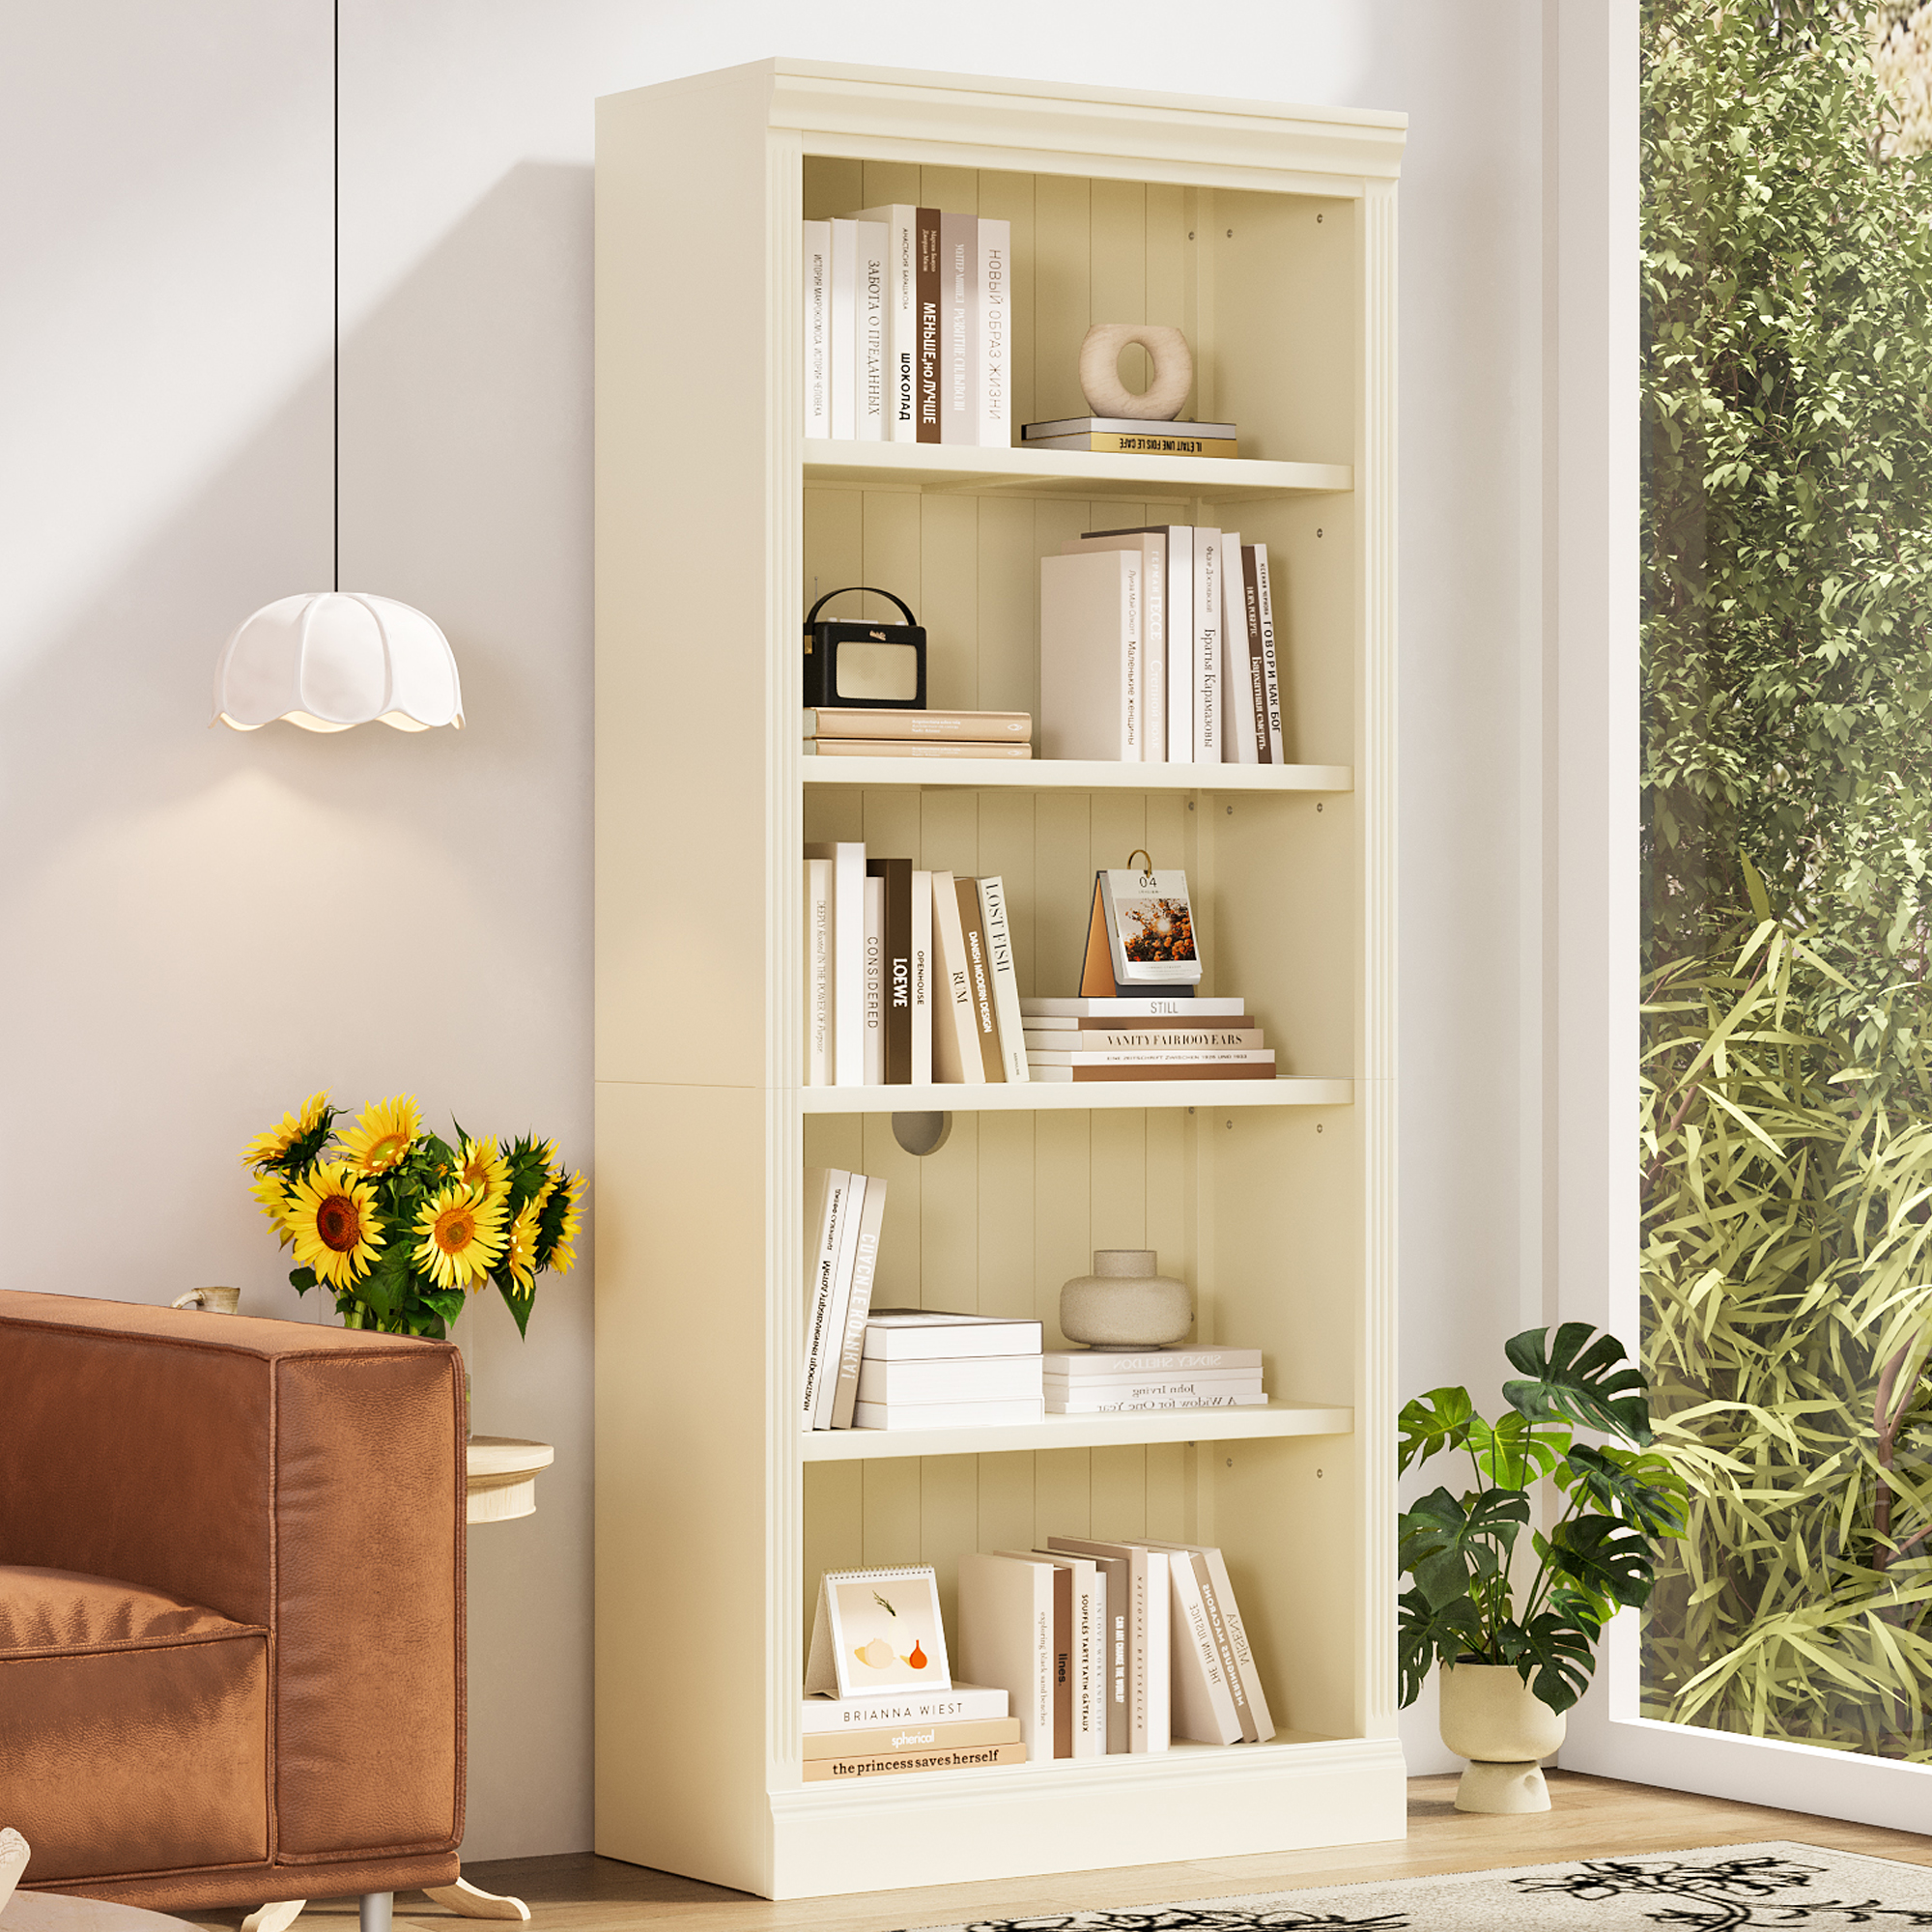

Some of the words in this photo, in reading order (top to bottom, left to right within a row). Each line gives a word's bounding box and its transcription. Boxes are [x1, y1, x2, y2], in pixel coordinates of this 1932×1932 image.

[867, 260, 881, 310] ЗАБОТА
[989, 249, 1003, 305] НОВЫЙ
[867, 316, 880, 327] О
[989, 310, 1002, 359] ОБРАЗ
[866, 329, 880, 415] ПРЕДАННЫХ
[899, 353, 910, 421] ШОКОЛАД
[989, 363, 1002, 419] ЖИЗНИ
[923, 380, 936, 424] ЛУЧШЕ
[1138, 439, 1146, 449] LE
[1150, 596, 1161, 640] ГЕССЕ
[1127, 640, 1136, 696] Маленькие
[1201, 629, 1216, 670] Братья
[1264, 621, 1275, 678] ГОВОРИ
[1148, 660, 1162, 717] Степной
[1250, 656, 1264, 712] Бархатная
[1268, 684, 1278, 706] КАК
[1126, 697, 1135, 746] женщины
[1201, 674, 1216, 748] Карамазовы
[1270, 711, 1281, 733] БОГ
[1254, 713, 1267, 750] смерть
[1140, 877, 1157, 888] 04
[817, 900, 826, 928] DEEPLY
[985, 883, 1005, 927] LOST
[817, 955, 826, 964] IN
[968, 931, 981, 964] DANISH
[993, 932, 1010, 973] FISH
[817, 965, 826, 980] THE
[867, 937, 878, 1029] CONSIDERED
[893, 958, 908, 1008] LOEWE
[952, 971, 968, 1005] RUM
[974, 964, 987, 1001] MODERN
[817, 983, 826, 1011] POWER
[1151, 1001, 1179, 1013] STILL
[817, 1012, 826, 1024] OF
[980, 1002, 993, 1034] DESIGN
[1038, 1611, 1047, 1650] exploring
[1081, 1594, 1091, 1634] SOUFFLÉS
[1115, 1615, 1124, 1630] CAN
[843, 1707, 912, 1721] BRIANNA
[920, 1702, 963, 1716] WIEST
[1081, 1693, 1091, 1733] GÂTEAUX
[892, 1729, 935, 1748] spherical
[833, 1764, 856, 1775] the
[857, 1758, 913, 1776] princess
[915, 1756, 951, 1768] saves
[952, 1749, 999, 1765] herself
